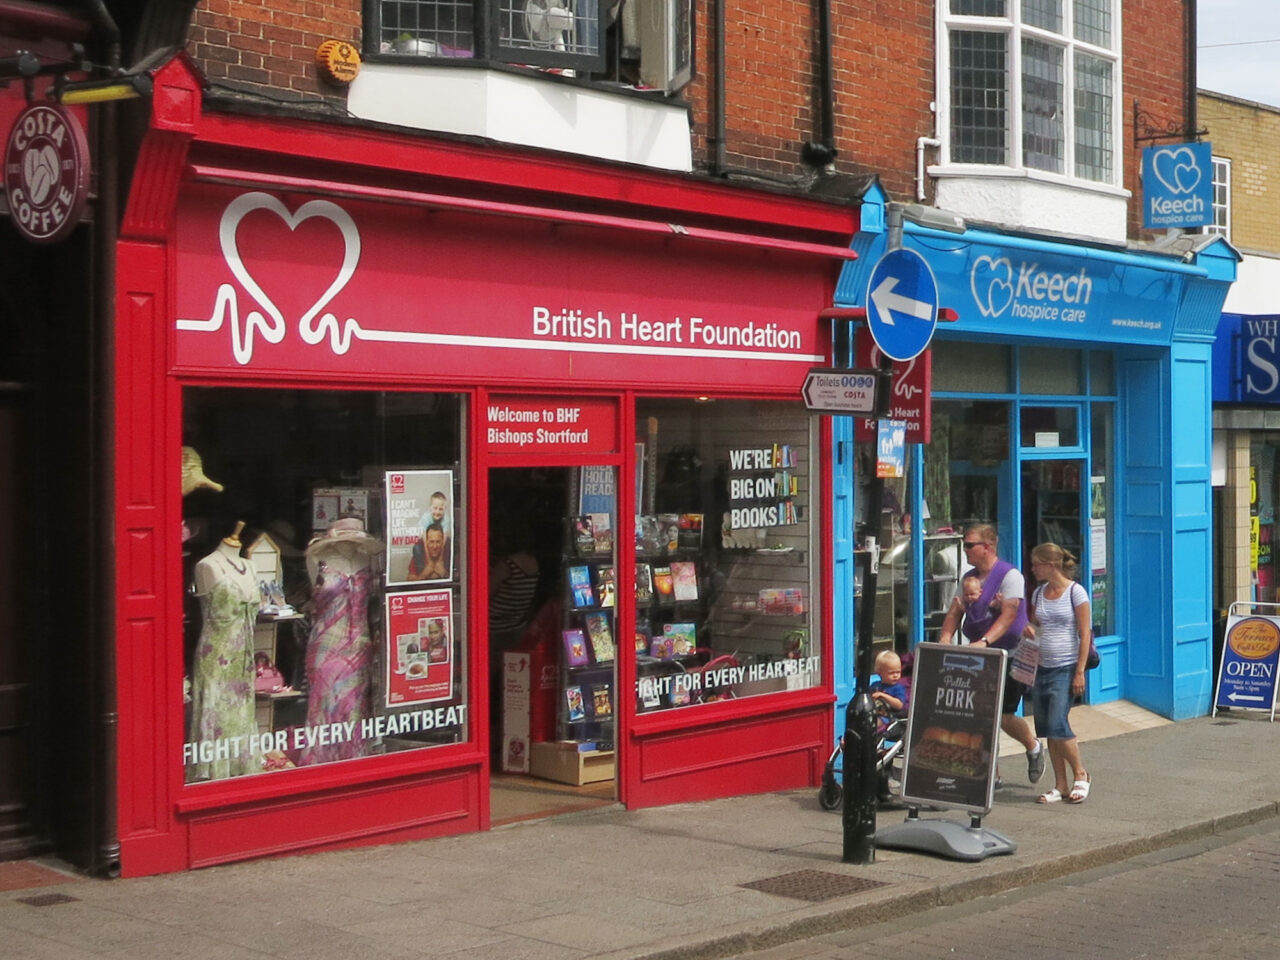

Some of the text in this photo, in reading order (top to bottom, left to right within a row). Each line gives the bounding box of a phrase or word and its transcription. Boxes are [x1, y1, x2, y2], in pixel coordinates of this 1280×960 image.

[15, 112, 66, 150] COSTA
[12, 186, 73, 232] COFFEE
[1151, 194, 1204, 215] Keech
[1151, 214, 1204, 224] hospice care
[1016, 261, 1093, 305] Keech
[1011, 300, 1087, 323] hospice care
[532, 306, 801, 349] British Heart Foundation
[1247, 320, 1278, 337] WH
[1246, 337, 1280, 395] S
[816, 375, 841, 388] Toilets
[843, 391, 867, 400] COSTA
[487, 406, 581, 423] Welcome to BHF
[894, 407, 920, 418] Heart
[487, 428, 589, 446] Bishops Stortford
[729, 449, 772, 470] WE'RE
[731, 478, 775, 500] BIG ON
[731, 506, 778, 529] BOOKS
[635, 656, 821, 699] IGHT FOR EVERY HEARTBEAT
[1226, 660, 1274, 678] OPEN
[935, 687, 976, 710] PORK
[183, 704, 467, 765] FIGHT FOR EVERY HEARTBEAT
